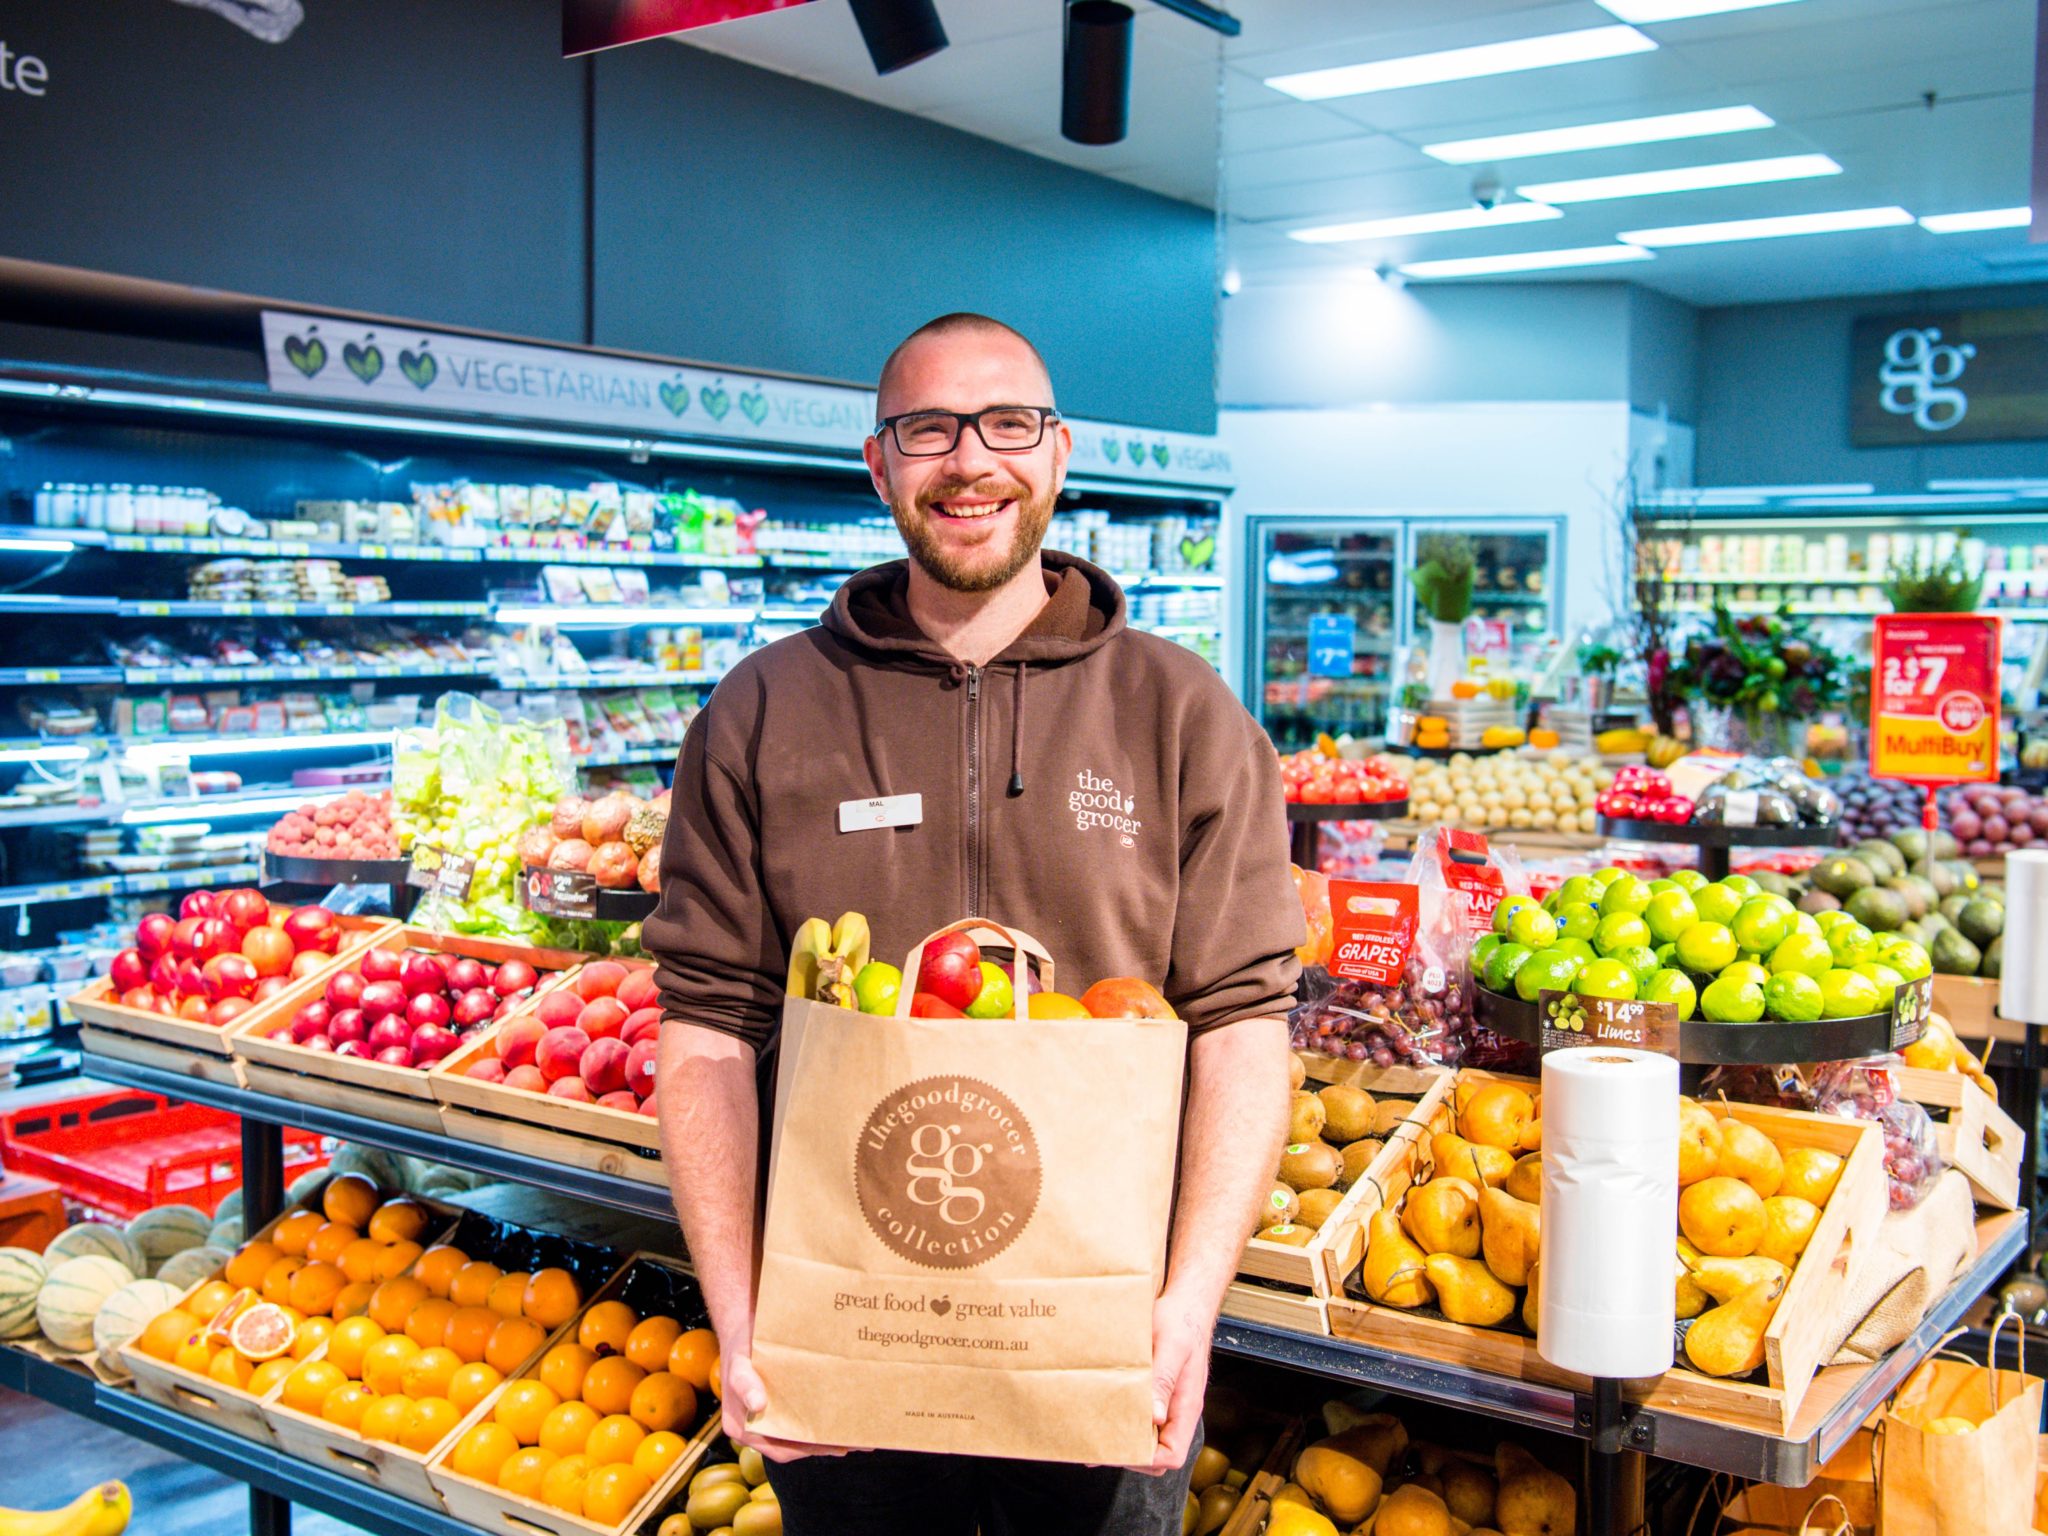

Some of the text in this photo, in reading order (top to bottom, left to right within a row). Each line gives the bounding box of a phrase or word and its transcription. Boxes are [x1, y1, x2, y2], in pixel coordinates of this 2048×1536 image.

[447, 357, 651, 408] VEGETARIAN
[775, 401, 866, 432] VEGAN
[1886, 735, 1984, 761] MultiBuy
[1077, 769, 1113, 792] the
[1069, 789, 1123, 811] good
[1077, 810, 1142, 835] grocer
[1338, 943, 1401, 966] GRAPES
[1597, 1023, 1641, 1043] Limes
[868, 1082, 1026, 1156] thegoodgrocer
[878, 1208, 1015, 1256] collection
[834, 1292, 1057, 1321] great food great value
[858, 1326, 1028, 1351] thegoodgrocer.com.au
[937, 1413, 975, 1421] AUSTRALIA
